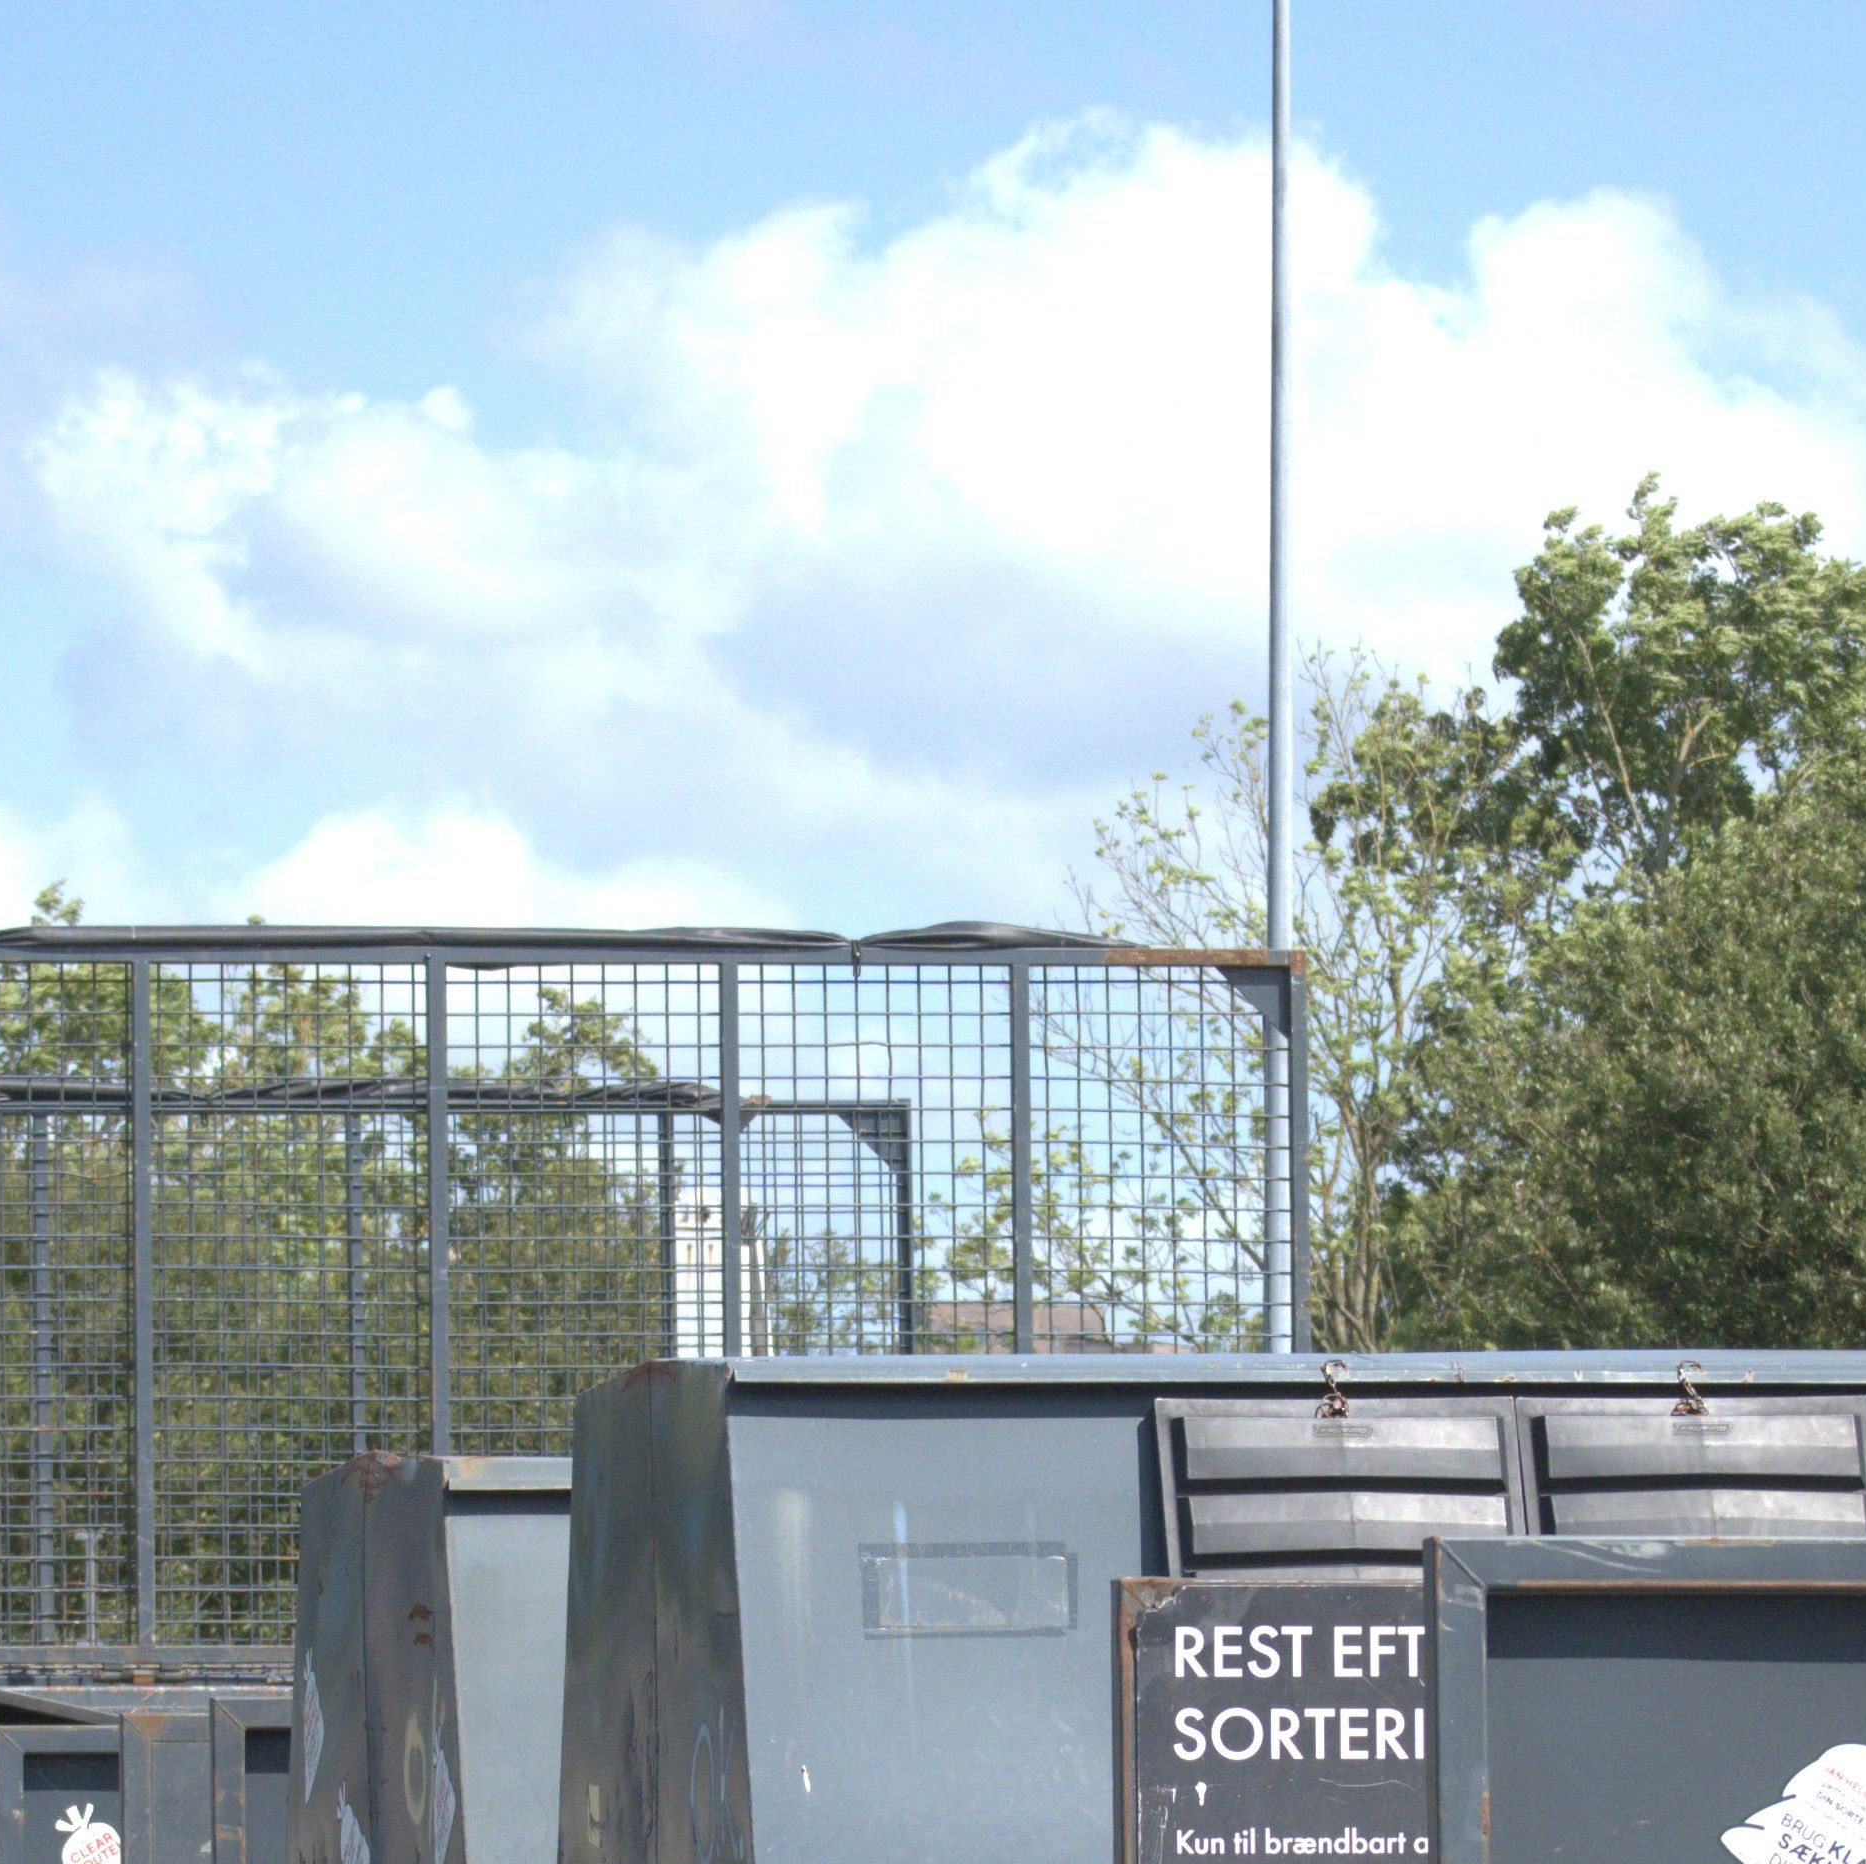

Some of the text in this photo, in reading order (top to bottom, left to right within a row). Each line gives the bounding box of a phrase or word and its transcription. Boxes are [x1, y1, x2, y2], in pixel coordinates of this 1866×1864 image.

[1174, 1625, 1426, 1678] REST EFT
[1173, 1707, 1425, 1761] SORTERI
[70, 1832, 114, 1864] CLEAR
[1176, 1829, 1225, 1855] Kun
[1234, 1827, 1256, 1854] til
[1265, 1827, 1407, 1855] brændbart
[1781, 1813, 1826, 1850] BRUG
